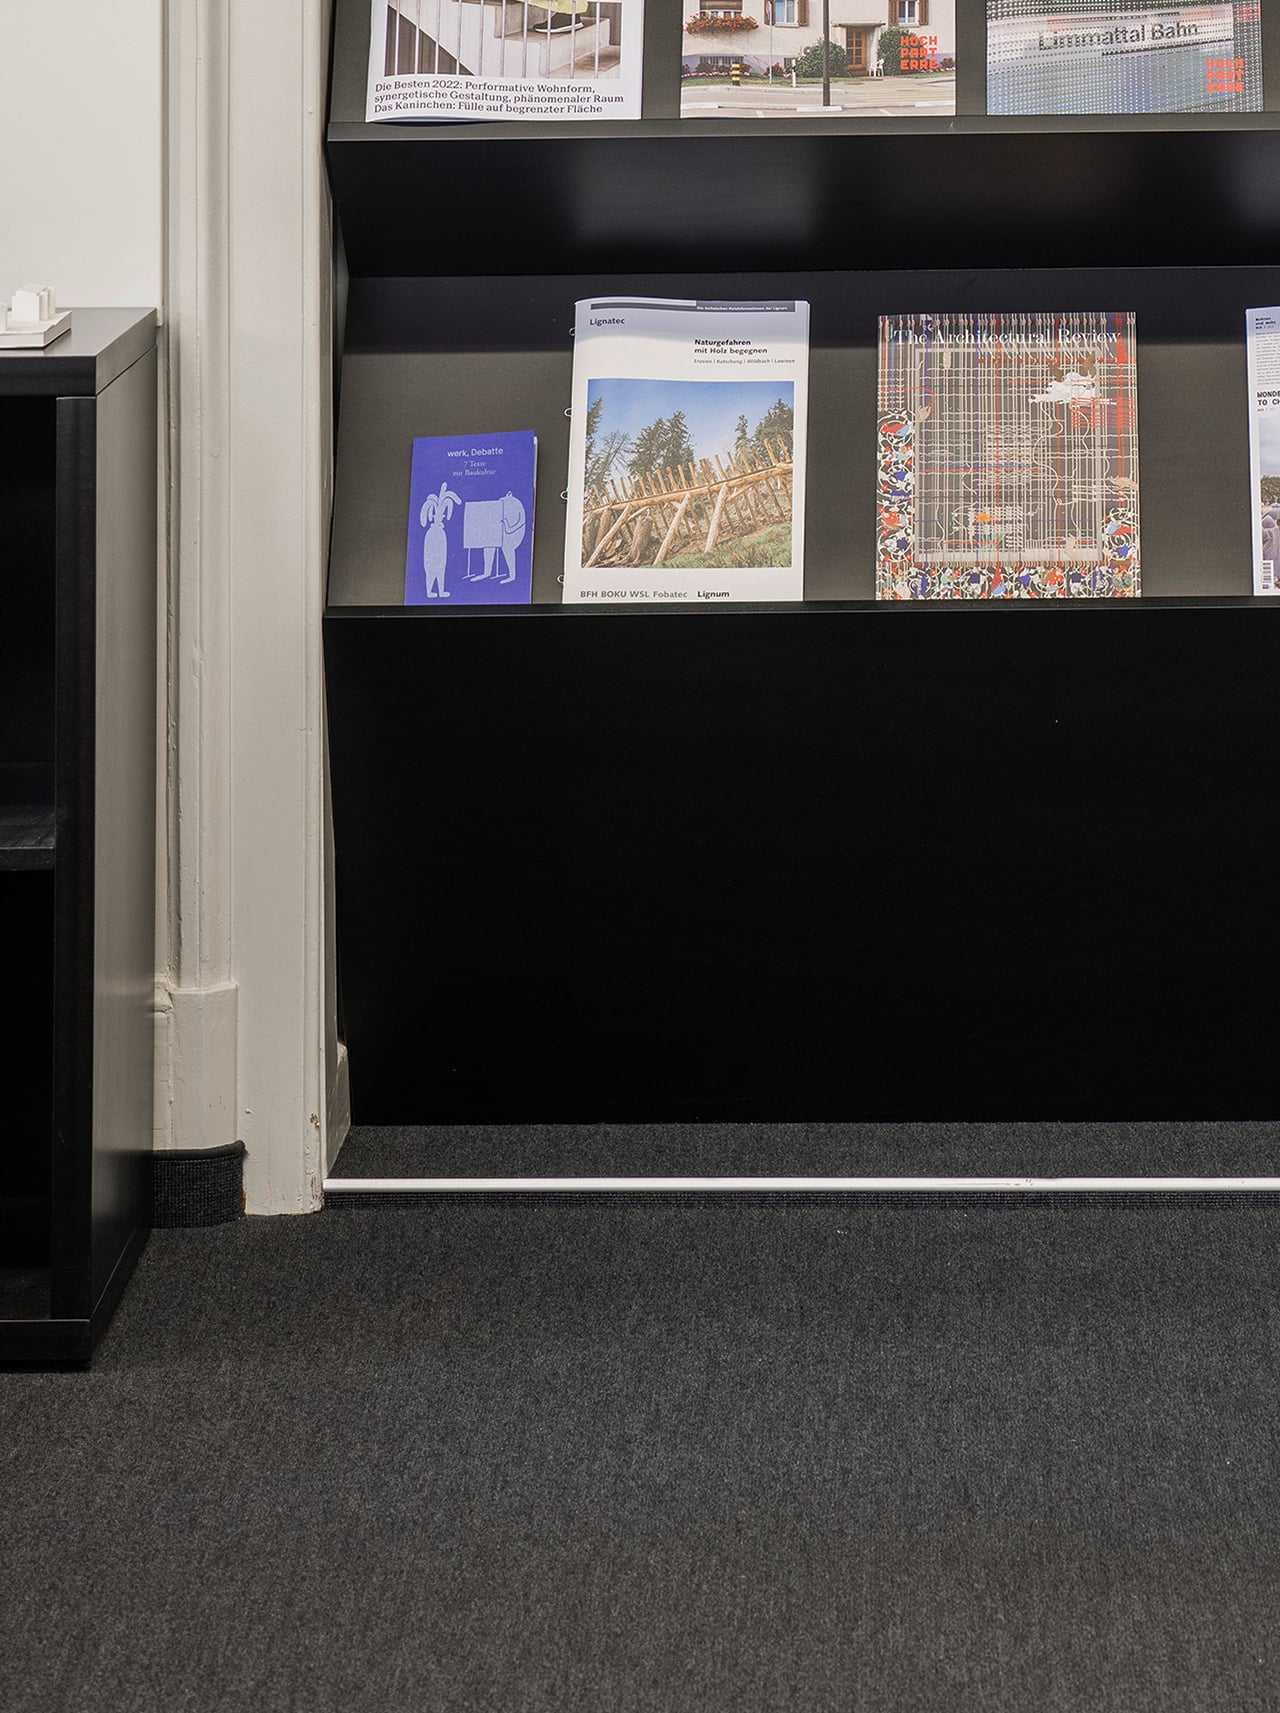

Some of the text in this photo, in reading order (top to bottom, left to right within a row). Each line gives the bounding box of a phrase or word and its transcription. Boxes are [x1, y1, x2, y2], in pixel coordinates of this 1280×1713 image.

[900, 36, 937, 46] HOCH
[1038, 23, 1198, 50] Limmattal Bahn
[900, 48, 937, 58] PART
[900, 59, 938, 70] ERRE
[1206, 58, 1244, 68] HOCH
[1206, 70, 1244, 80] PART
[375, 80, 596, 94] Die Besten 2022: Performative Wohnform,
[374, 90, 624, 104] synergetische Gestaltung, phänomenaler Raum
[374, 100, 603, 114] Das Kaninchen: Fülle auf begrenzter Fläche
[590, 318, 626, 326] Lignatec
[894, 328, 1121, 345] The Architectural Review
[694, 339, 751, 347] Naturgefahren
[448, 448, 504, 458] werk, Debatte
[464, 468, 496, 476] Baukultur
[698, 590, 730, 599] Lignum
